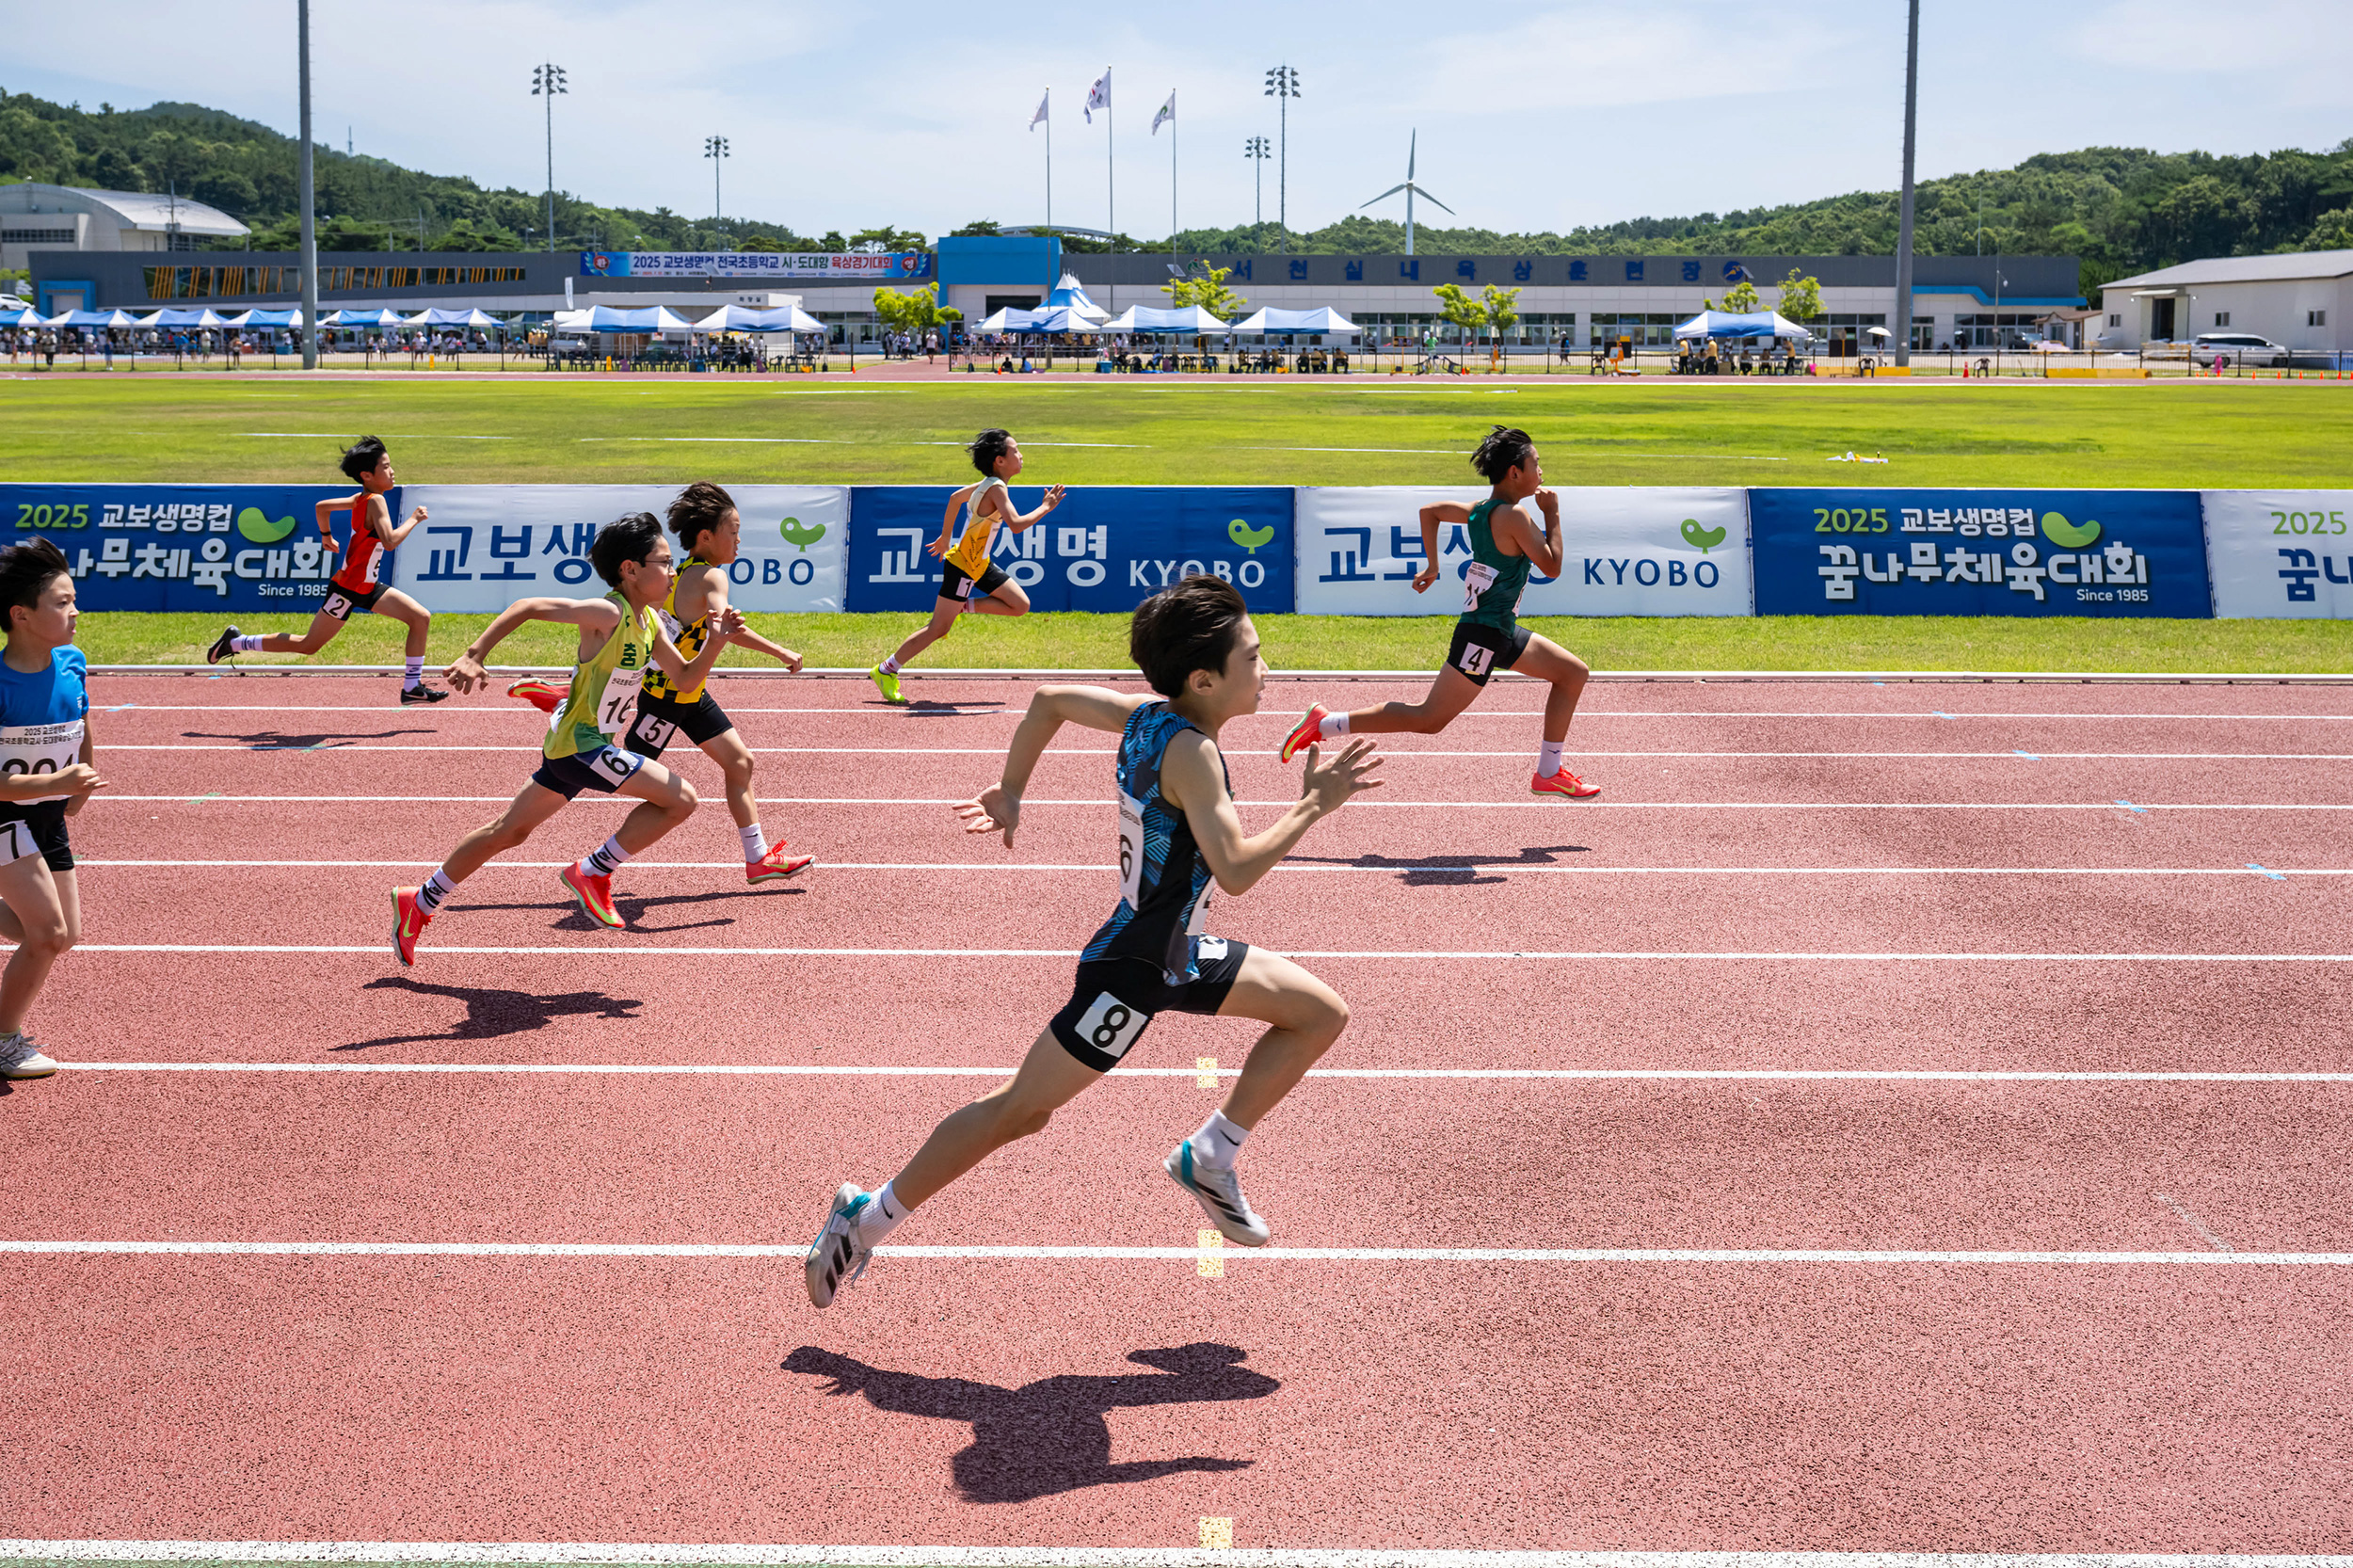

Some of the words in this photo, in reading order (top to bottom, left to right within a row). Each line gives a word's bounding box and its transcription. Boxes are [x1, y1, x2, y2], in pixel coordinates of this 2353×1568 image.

[633, 255, 661, 268] 2025
[717, 255, 779, 269] 전국초등학교
[831, 256, 893, 269] 육상경기대회
[15, 504, 89, 529] 2025
[98, 504, 233, 533] 교보생명컵
[1813, 508, 1889, 534] 2025
[1899, 507, 2036, 537] 교보생명컵
[2271, 511, 2347, 536] 2025
[15, 537, 333, 596] 나무체육대회
[416, 522, 597, 584] 교보생
[728, 557, 815, 585] OBO
[869, 524, 1108, 587] 교생명
[1130, 559, 1265, 588] KYOBO
[1584, 558, 1721, 589] KYOBO
[1817, 540, 2149, 601] 꿈나무체육대회
[258, 584, 295, 597] Since
[297, 584, 328, 598] 1985
[966, 580, 973, 597] 1
[2076, 588, 2114, 601] Since
[2116, 589, 2149, 602] 1985
[332, 598, 345, 616] 2
[1467, 648, 1484, 672] 4
[644, 719, 667, 744] 5
[600, 752, 631, 776] 6
[0, 822, 20, 860] 7
[1092, 1003, 1130, 1048] 8
